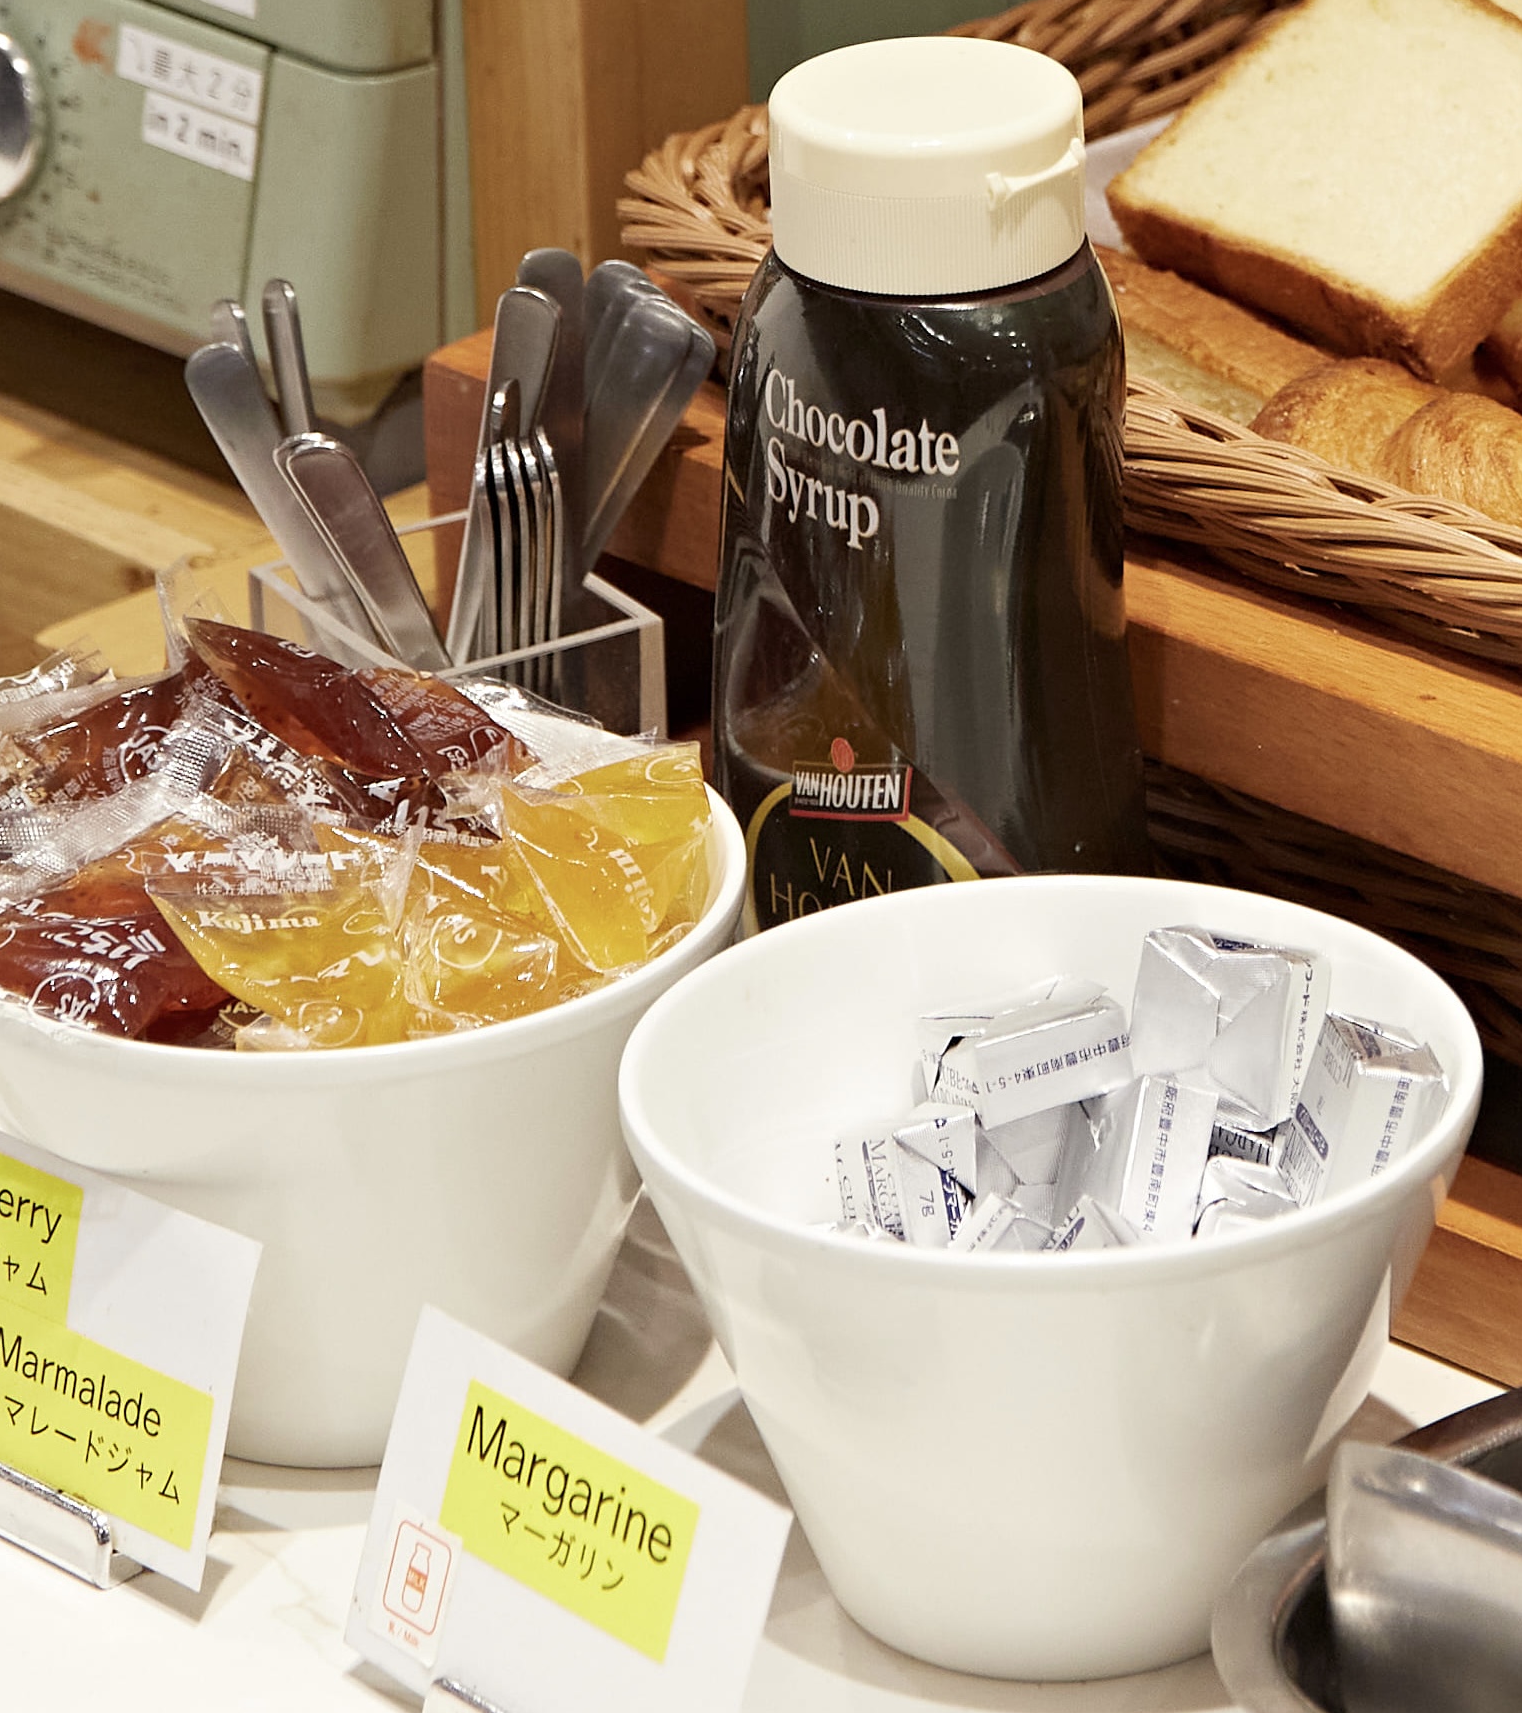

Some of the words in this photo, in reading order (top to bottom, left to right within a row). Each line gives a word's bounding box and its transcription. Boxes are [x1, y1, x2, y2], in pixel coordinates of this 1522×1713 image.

[175, 111, 190, 145] 2
[764, 368, 961, 476] Chocolate
[766, 436, 880, 551] Syrup
[809, 836, 892, 900] VAN
[194, 909, 322, 935] Kojima
[1142, 1080, 1179, 1232] 阪府豊中市豊南町東4
[466, 1404, 673, 1564] Margarine
[500, 1501, 624, 1592] マーガリン
